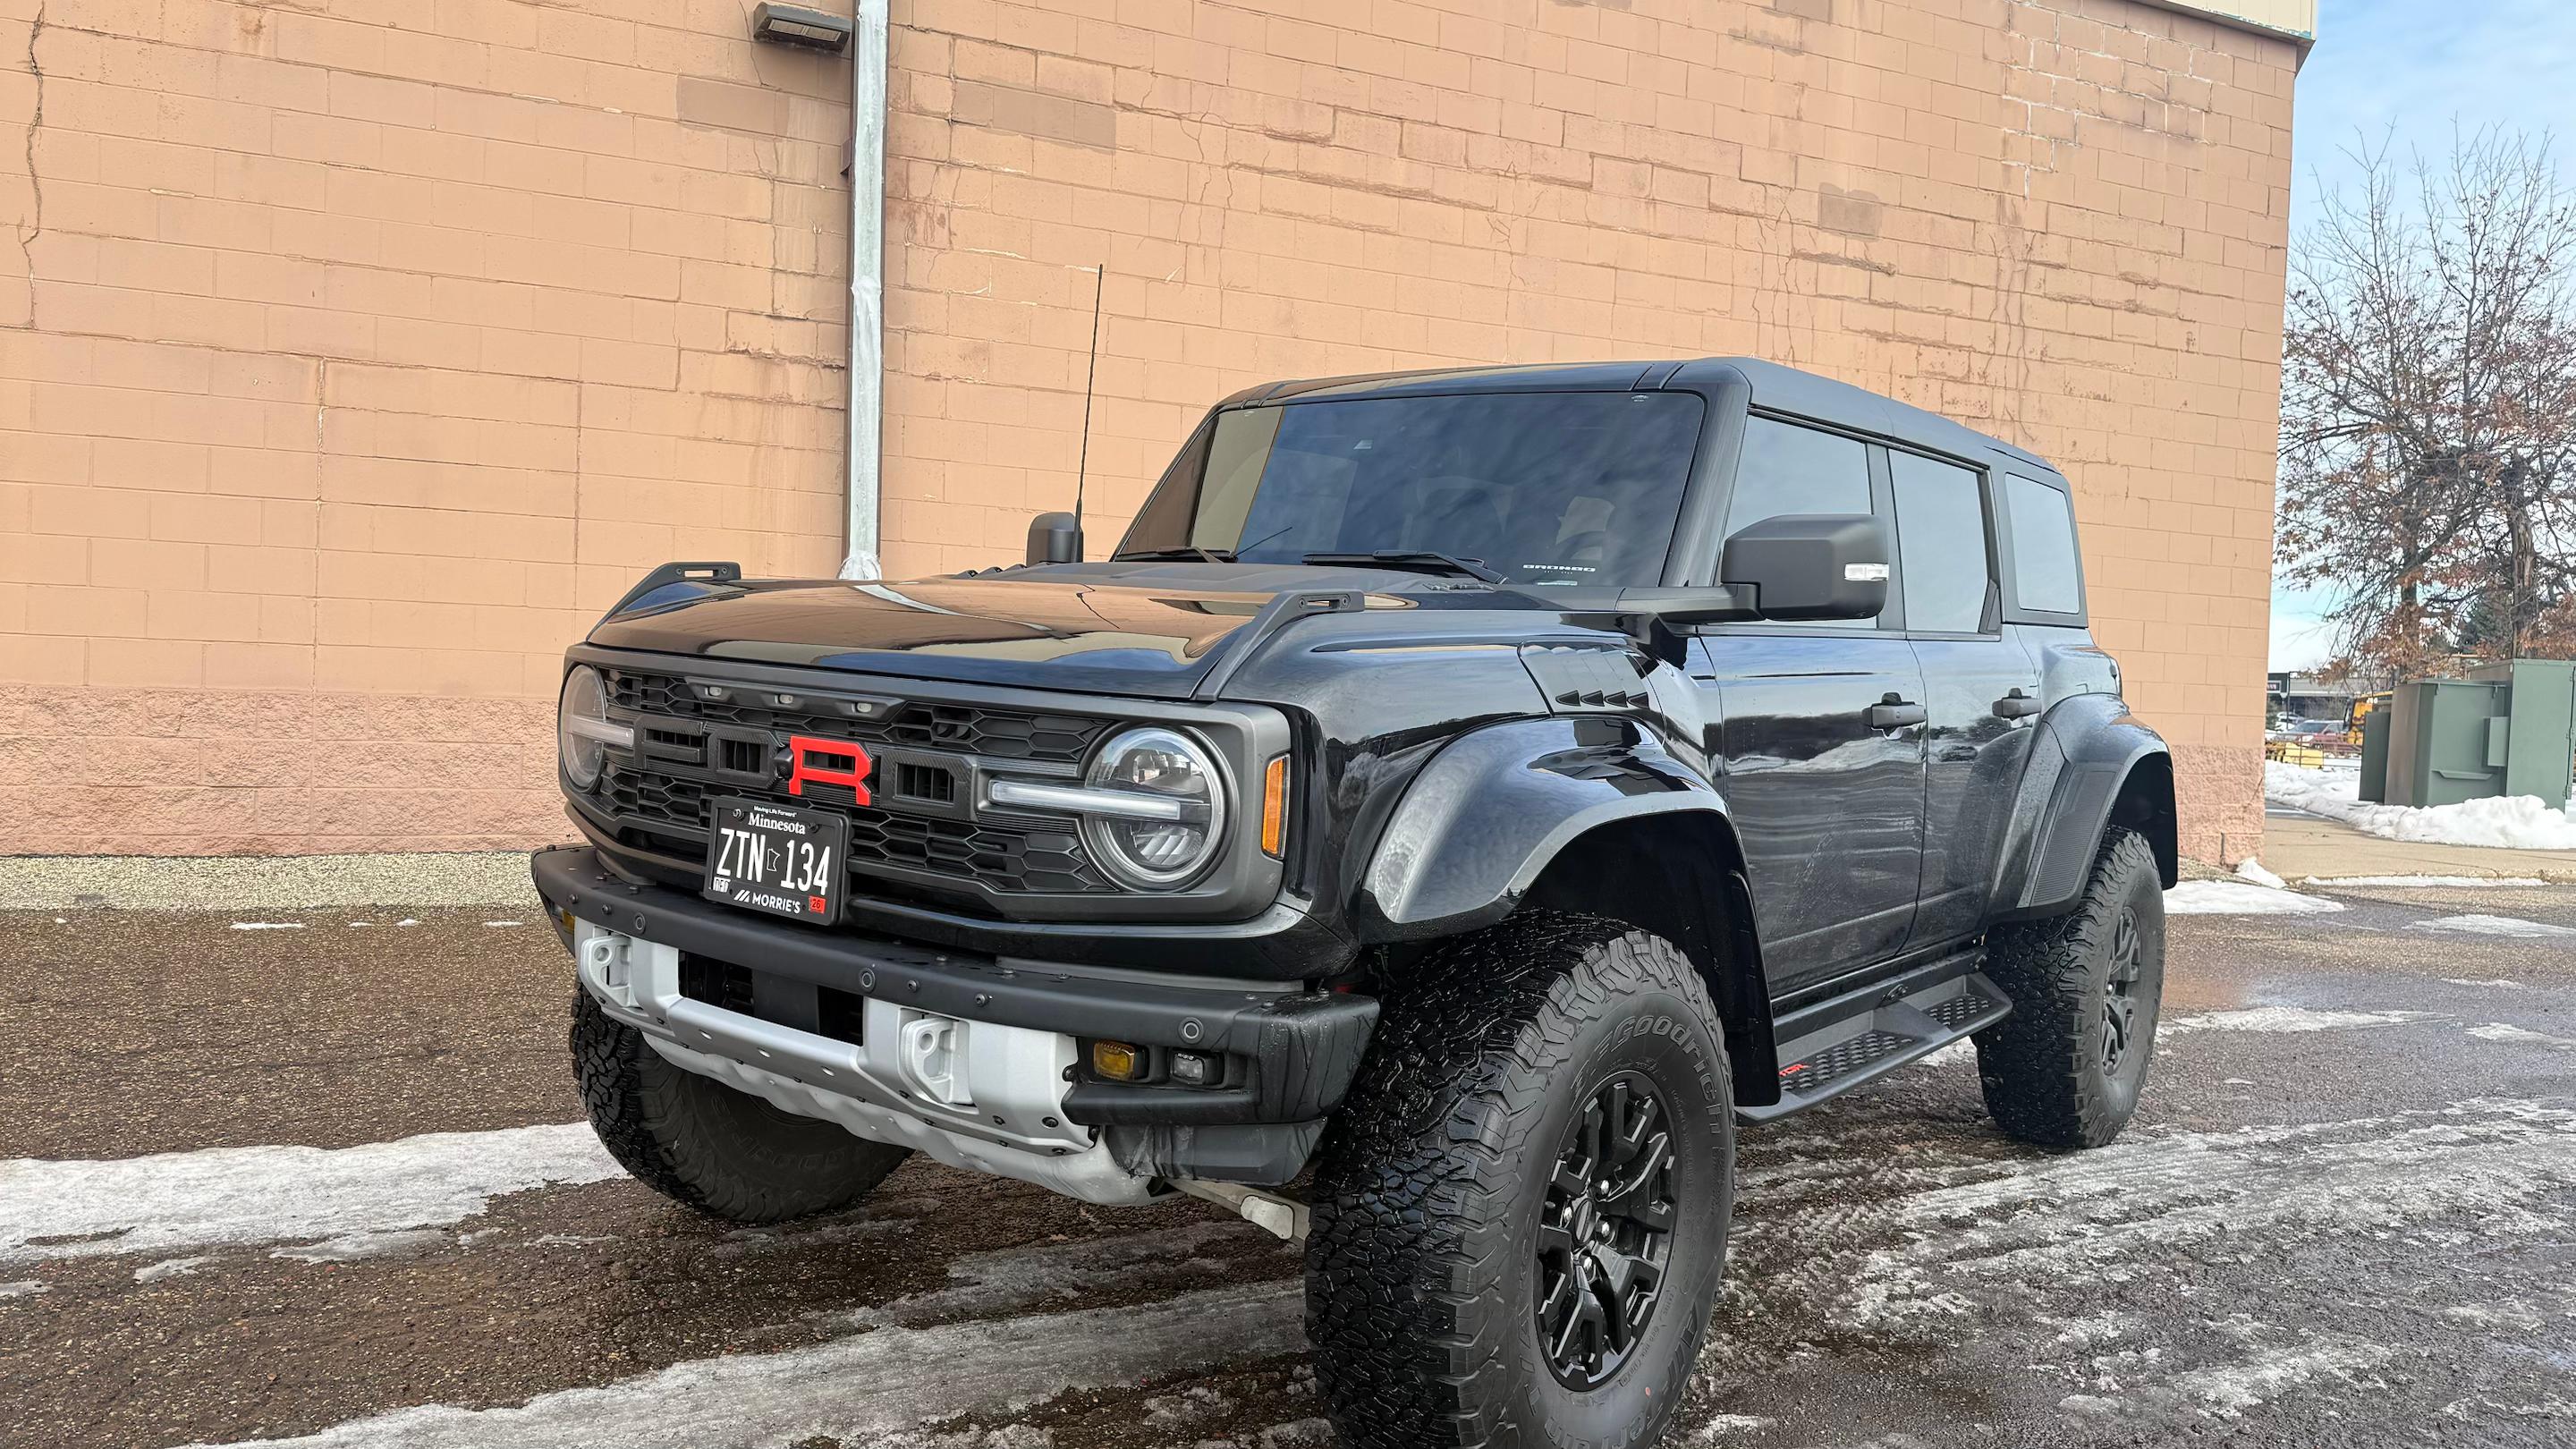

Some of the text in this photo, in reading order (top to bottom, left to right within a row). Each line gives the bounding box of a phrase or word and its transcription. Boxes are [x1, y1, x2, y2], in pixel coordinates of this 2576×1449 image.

[635, 713, 977, 821] FORD
[748, 812, 806, 835] Minnesota
[716, 827, 830, 896] ZTN 134
[752, 893, 801, 913] MORRIE'S
[811, 899, 821, 909] 26
